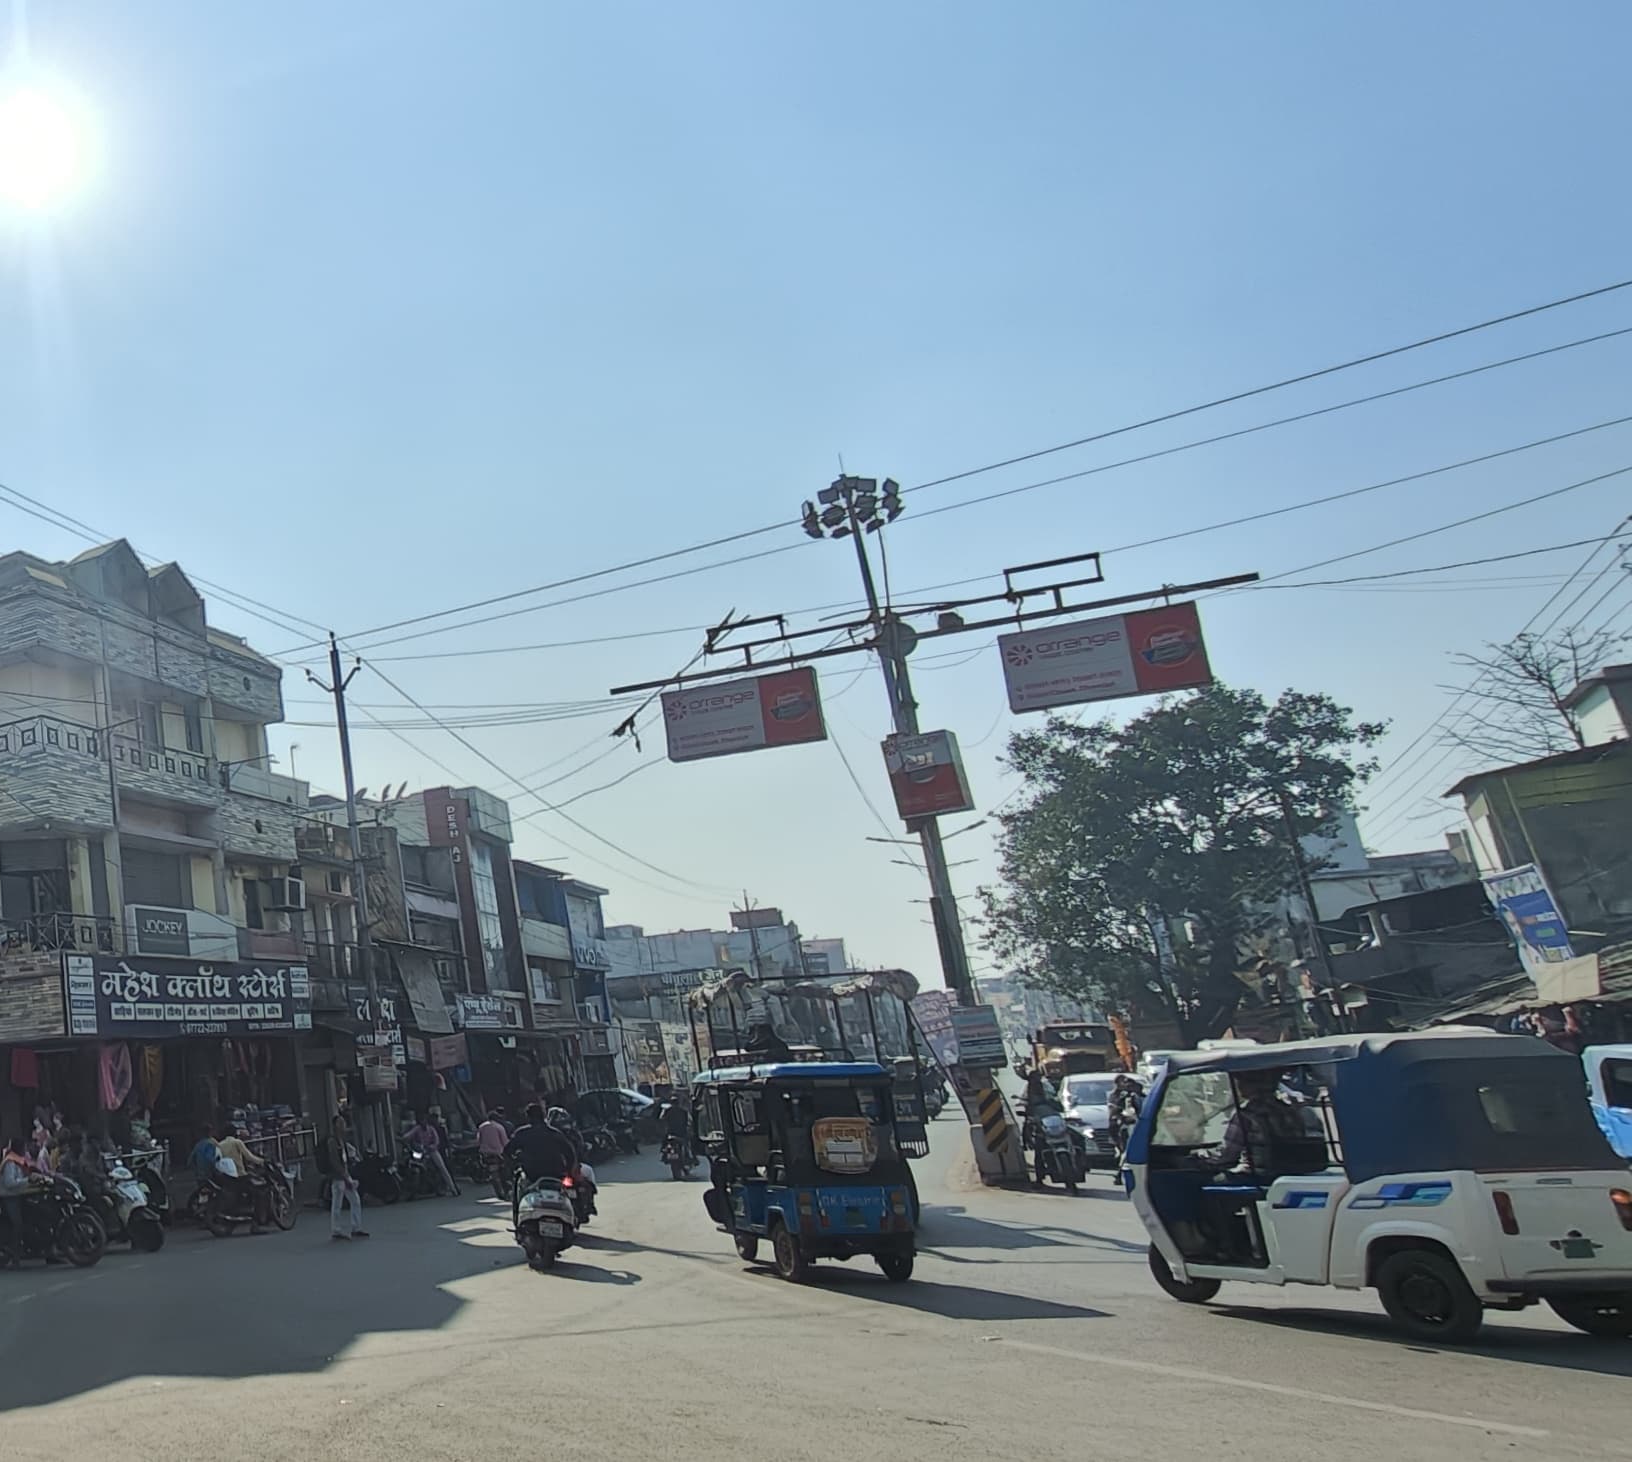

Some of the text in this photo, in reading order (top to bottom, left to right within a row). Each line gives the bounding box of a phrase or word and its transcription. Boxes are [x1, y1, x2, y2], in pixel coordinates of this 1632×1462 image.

[143, 919, 182, 935] JOCKEY
[99, 961, 287, 1002] महेश क्लॉथ स्टोर्स
